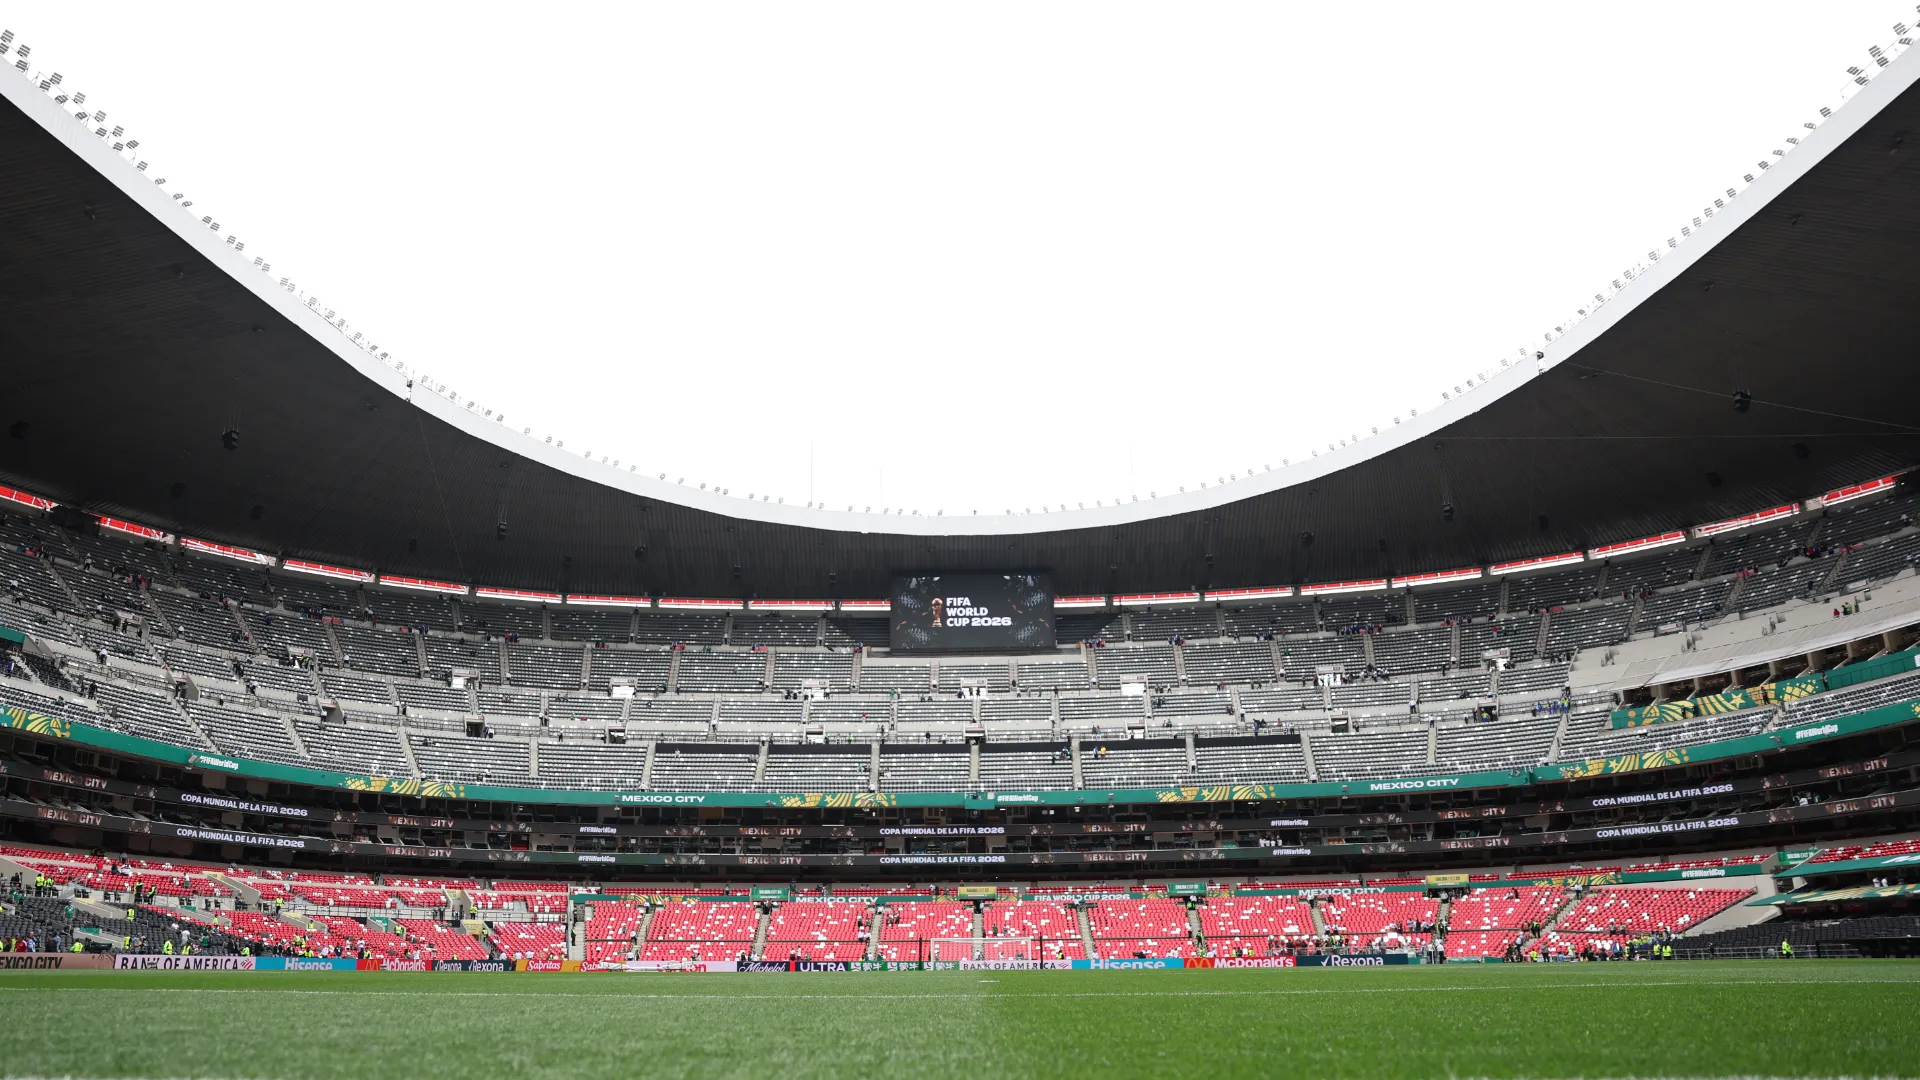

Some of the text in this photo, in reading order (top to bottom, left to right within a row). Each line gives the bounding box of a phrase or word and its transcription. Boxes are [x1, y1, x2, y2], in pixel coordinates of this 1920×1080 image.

[946, 597, 971, 606] FIFA
[946, 607, 988, 616] WORLD
[946, 617, 1012, 626] CUP 2026
[1864, 758, 1888, 770] CITY
[85, 777, 107, 789] CITY
[1370, 778, 1460, 790] MEXICO CITY
[1593, 797, 1615, 807] COPA
[1617, 793, 1656, 805] MUNDIAL
[1657, 792, 1668, 800] DE
[1682, 788, 1701, 797] FIFA
[1703, 784, 1733, 794] 2026
[181, 794, 201, 803] COPA
[203, 796, 237, 808] MUNDIAL
[262, 804, 278, 813] FIFA
[280, 808, 308, 816] 2026
[1825, 796, 1896, 815] MEXIC CITY
[1438, 808, 1506, 819] MEXIC CITY
[79, 815, 101, 825] CITY
[388, 816, 454, 828] MEXIC CITY
[1597, 829, 1620, 838] COPA
[1622, 825, 1660, 836] MUNDIAL
[1687, 820, 1706, 829] FIFA
[1708, 817, 1739, 827] 2026
[177, 828, 197, 837] COPA
[199, 831, 233, 842] MUNDIAL
[276, 839, 304, 848] 2026
[1485, 838, 1509, 846] CITY
[428, 849, 452, 858] CITY
[35, 956, 63, 969] CITY
[164, 958, 181, 969] OF
[184, 958, 238, 969] AMERICA
[285, 958, 332, 970] Hisense
[382, 958, 426, 971] McDonald's
[440, 960, 462, 971] Rexona
[473, 960, 503, 971] Rexona
[527, 960, 560, 972] Sabritas
[1090, 960, 1165, 969] Hisense
[1214, 957, 1294, 968] McDonald's
[1332, 955, 1384, 966] Rexona
[739, 962, 786, 972] Michelob
[800, 962, 845, 971] ULTRA
